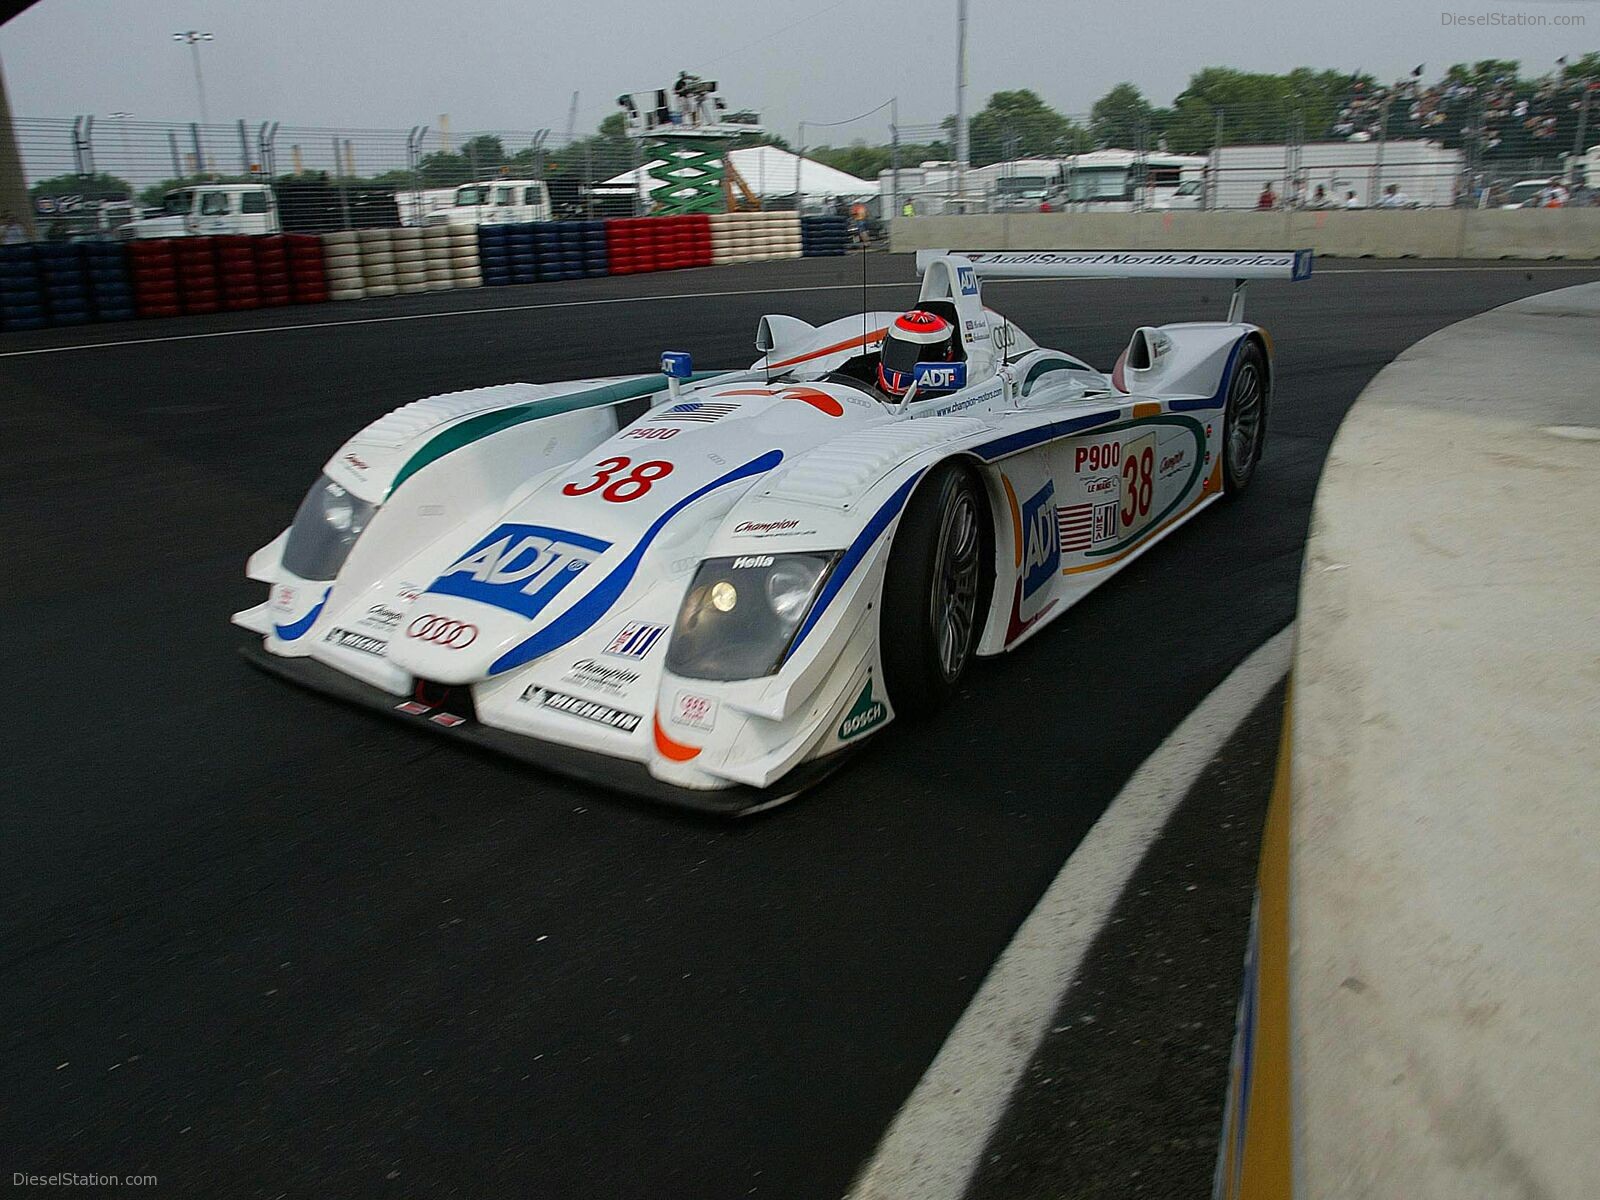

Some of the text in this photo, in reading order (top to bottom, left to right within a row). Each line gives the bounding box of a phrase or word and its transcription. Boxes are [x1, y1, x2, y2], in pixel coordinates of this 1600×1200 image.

[917, 368, 955, 388] ADT
[619, 428, 682, 440] P900
[1075, 441, 1120, 473] P900
[562, 456, 674, 503] 38
[1121, 446, 1154, 528] 38
[734, 518, 801, 533] Champion
[1023, 503, 1058, 579] ADT
[441, 533, 602, 597] ADT
[732, 555, 776, 570] Hella
[570, 658, 642, 684] Champion
[546, 692, 642, 730] MICHELIN
[842, 704, 882, 736] BOSCH
